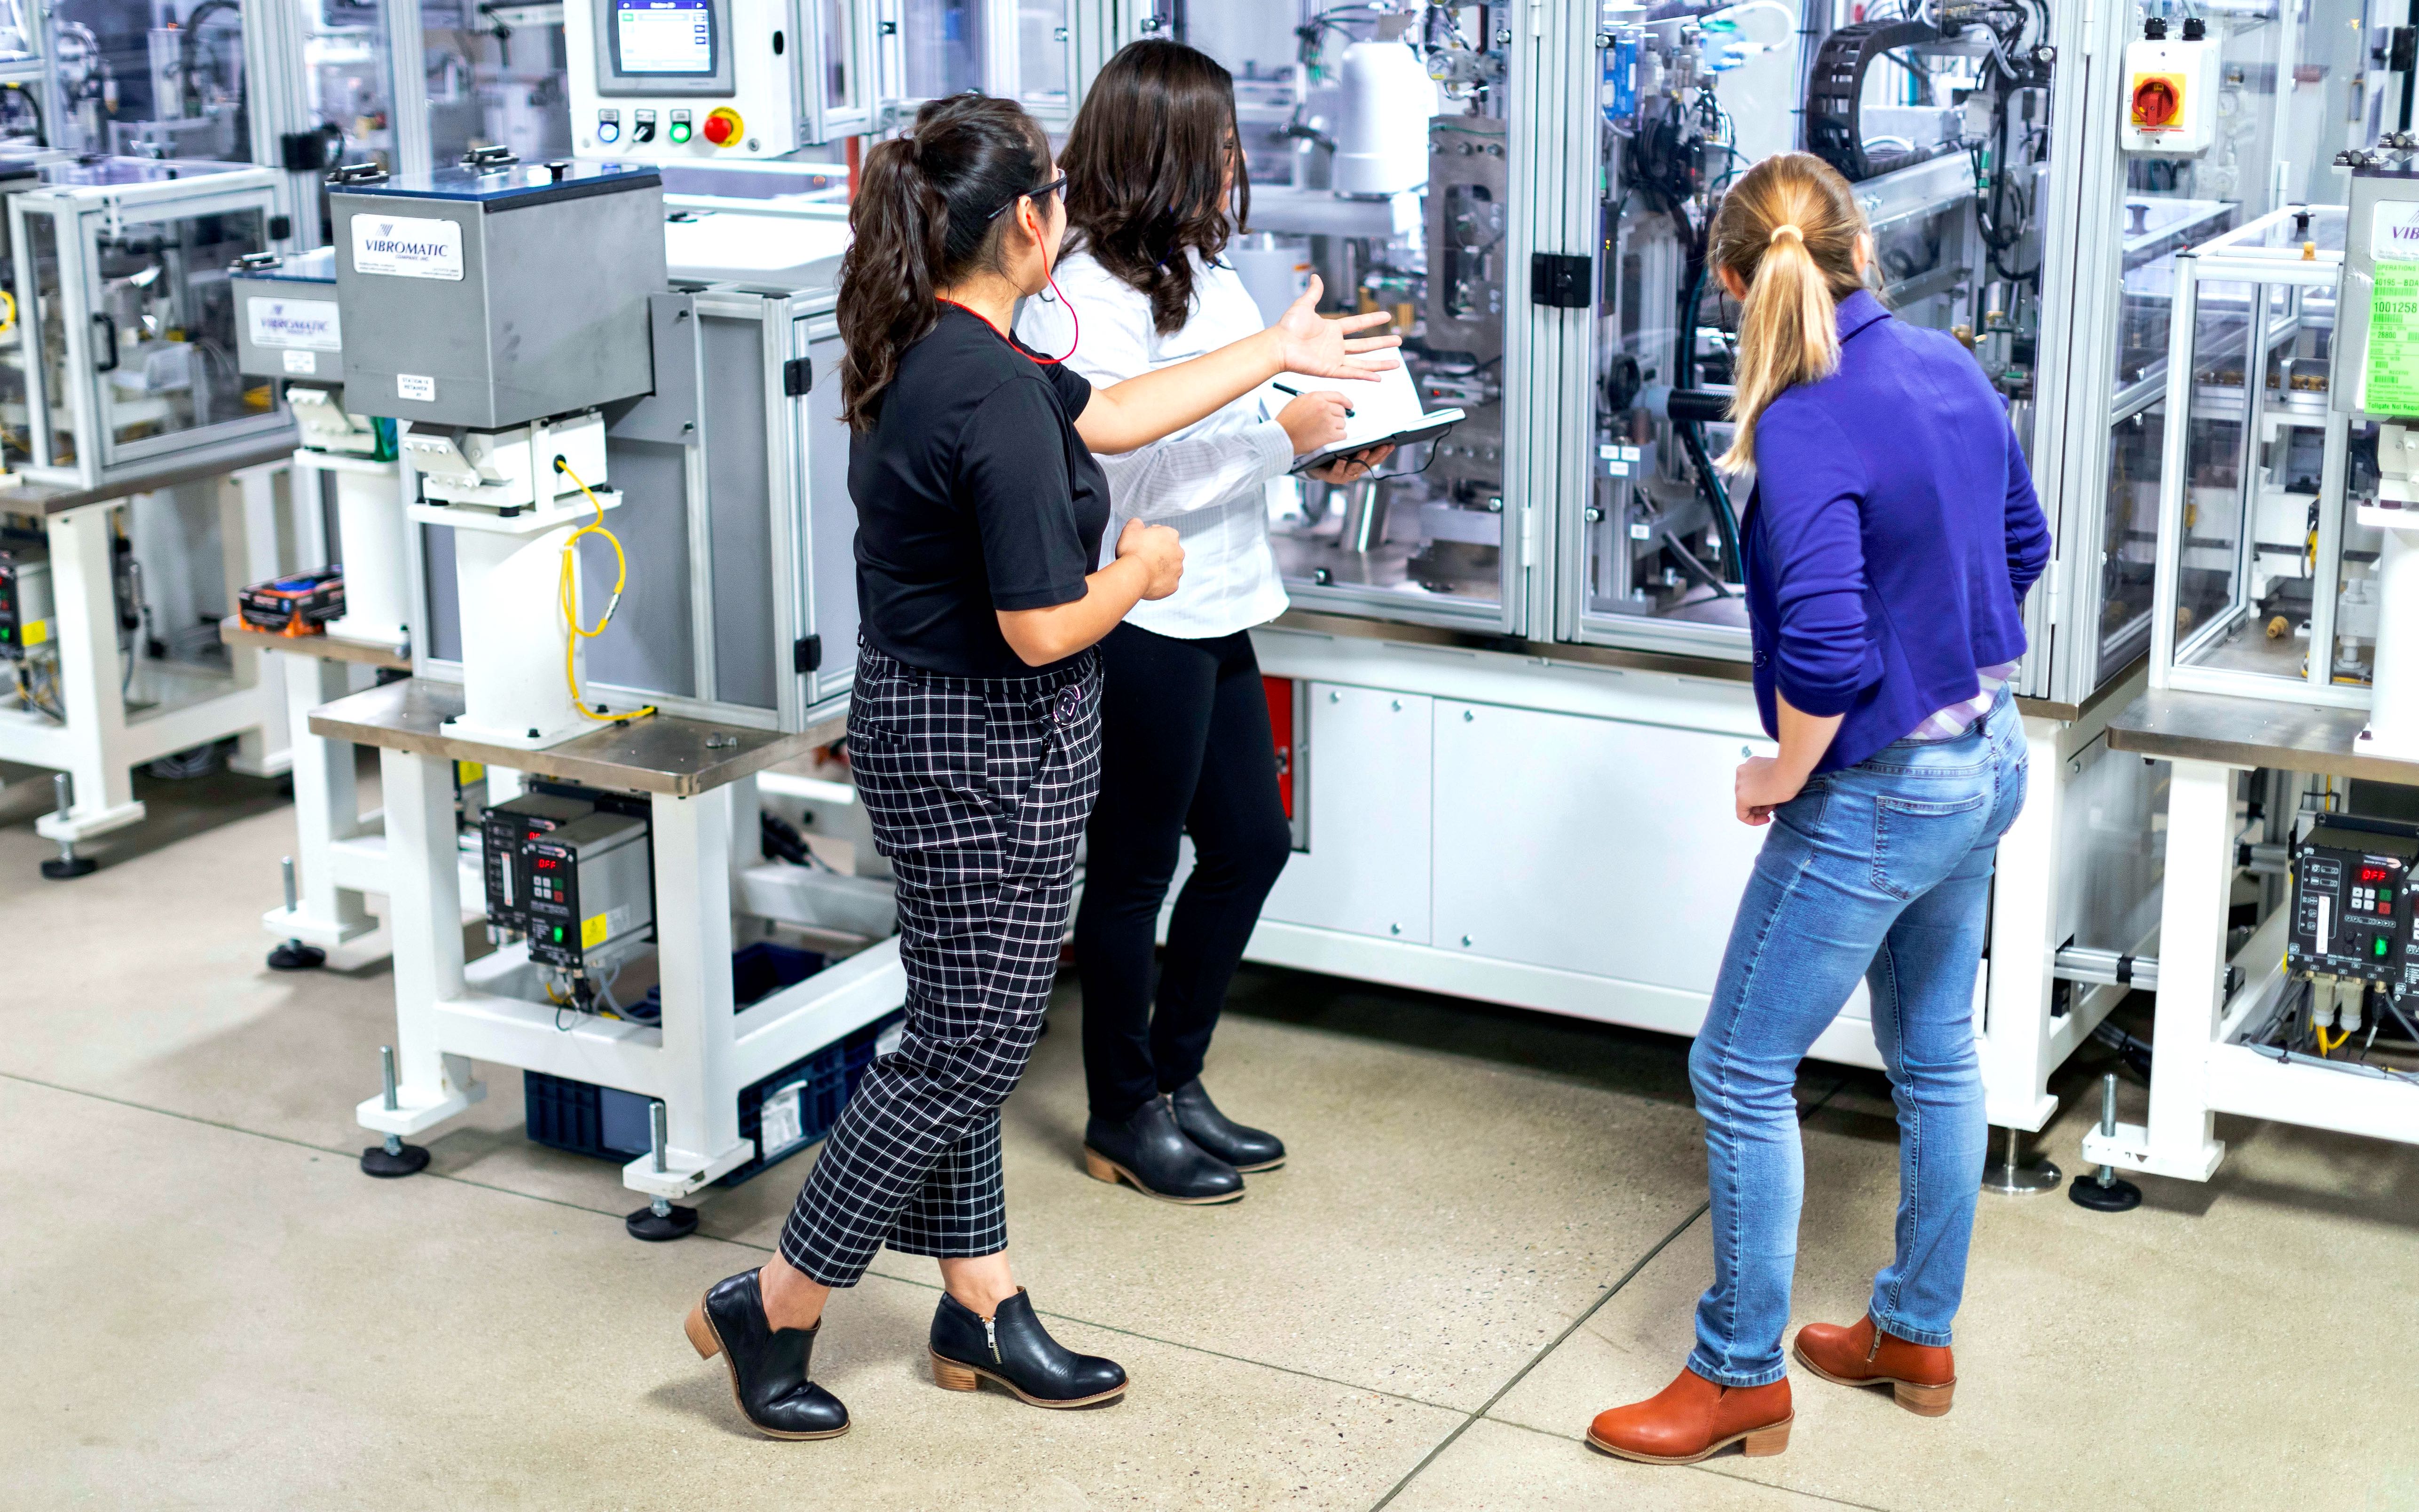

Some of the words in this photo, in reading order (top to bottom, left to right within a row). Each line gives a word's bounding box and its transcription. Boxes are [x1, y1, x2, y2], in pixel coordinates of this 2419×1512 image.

[366, 239, 448, 257] VIBROMATIC
[2374, 301, 2417, 313] 1001258
[538, 859, 556, 868] OFF
[2362, 869, 2386, 881] OFF
